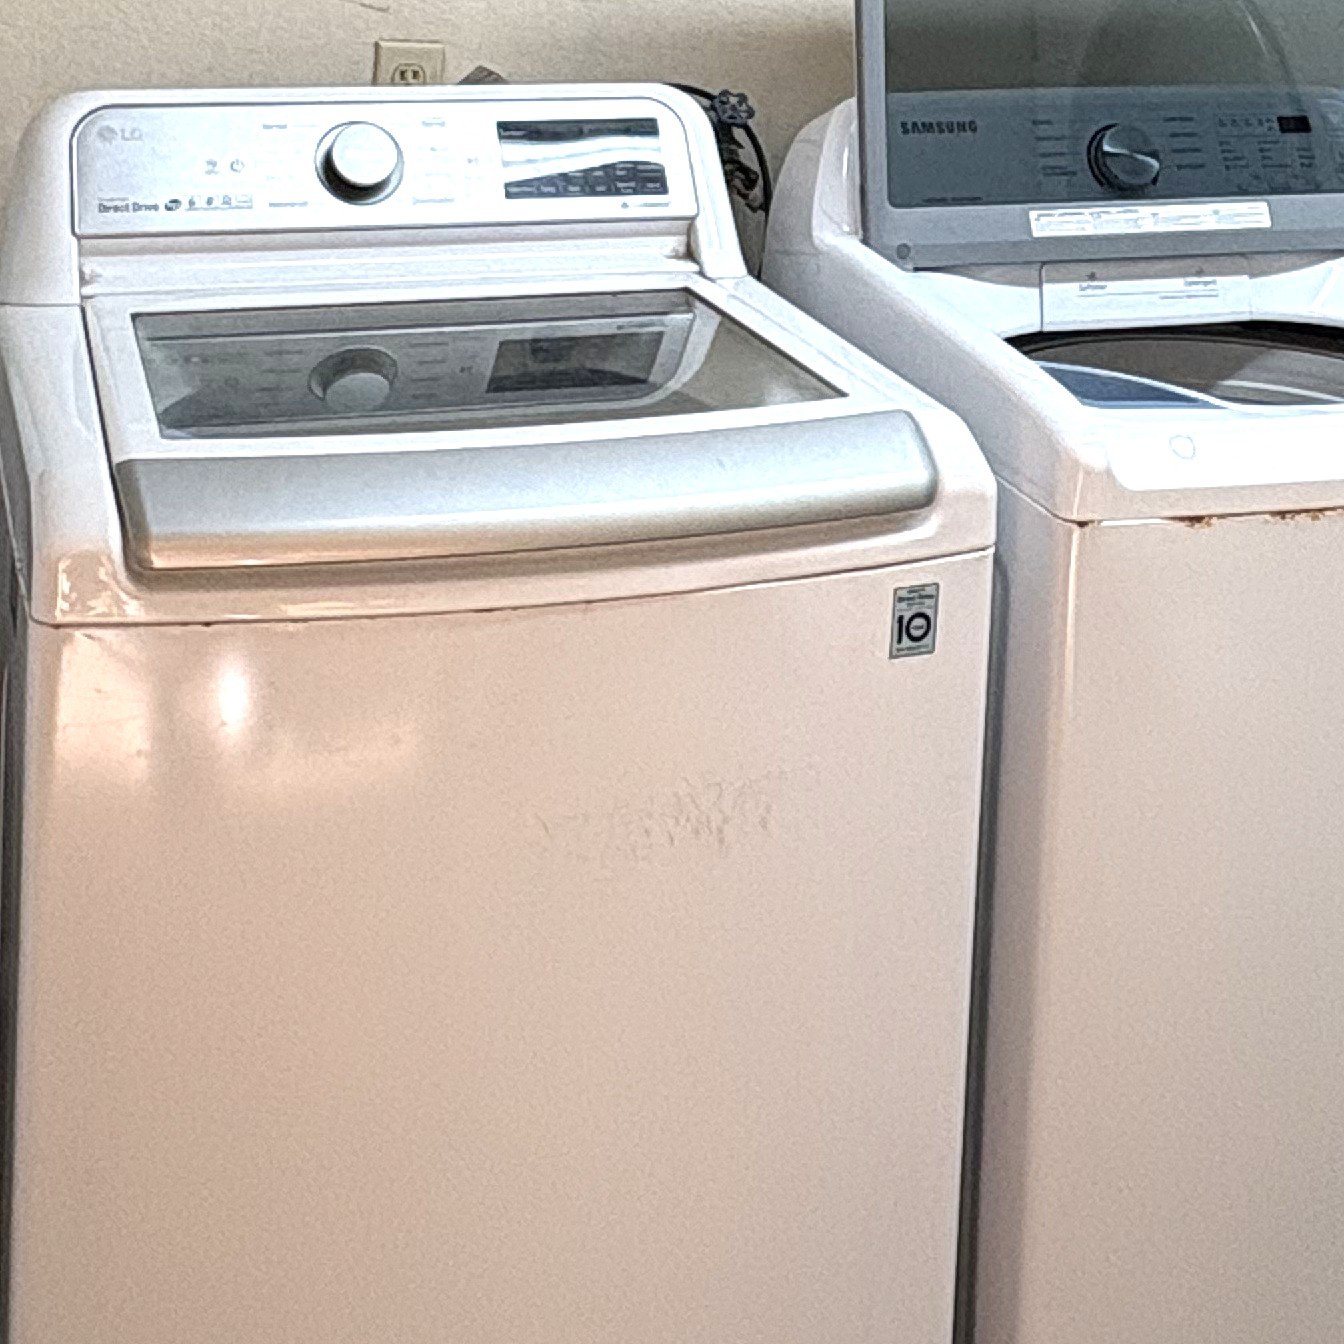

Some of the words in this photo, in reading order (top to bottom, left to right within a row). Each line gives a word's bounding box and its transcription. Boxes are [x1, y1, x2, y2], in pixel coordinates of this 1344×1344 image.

[120, 127, 143, 142] LG
[900, 120, 977, 135] SAMSUNG
[98, 202, 129, 213] Direct
[896, 611, 932, 646] 10
